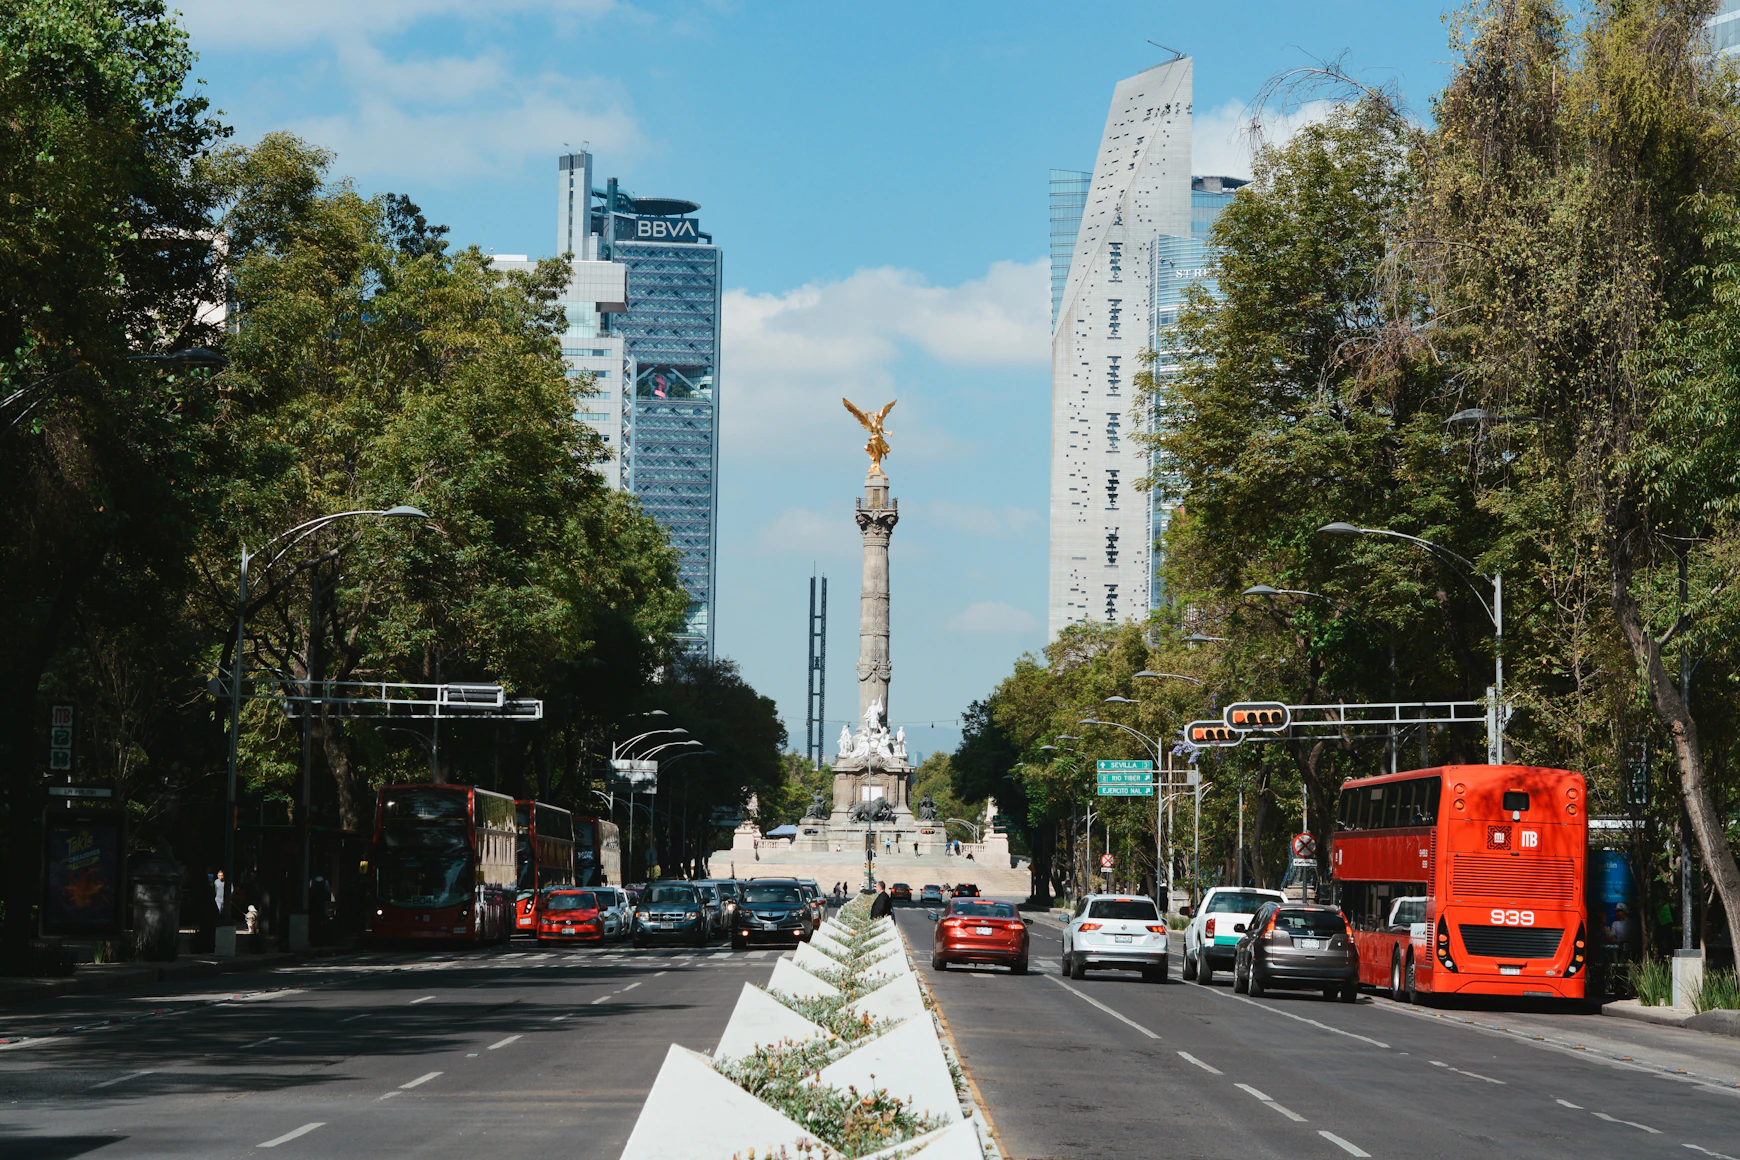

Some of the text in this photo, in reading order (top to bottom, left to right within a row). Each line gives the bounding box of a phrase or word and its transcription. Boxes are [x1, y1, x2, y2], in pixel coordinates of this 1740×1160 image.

[638, 220, 695, 237] BBVA
[66, 834, 94, 857] Takis
[1521, 830, 1539, 848] MB
[1490, 909, 1535, 926] 939
